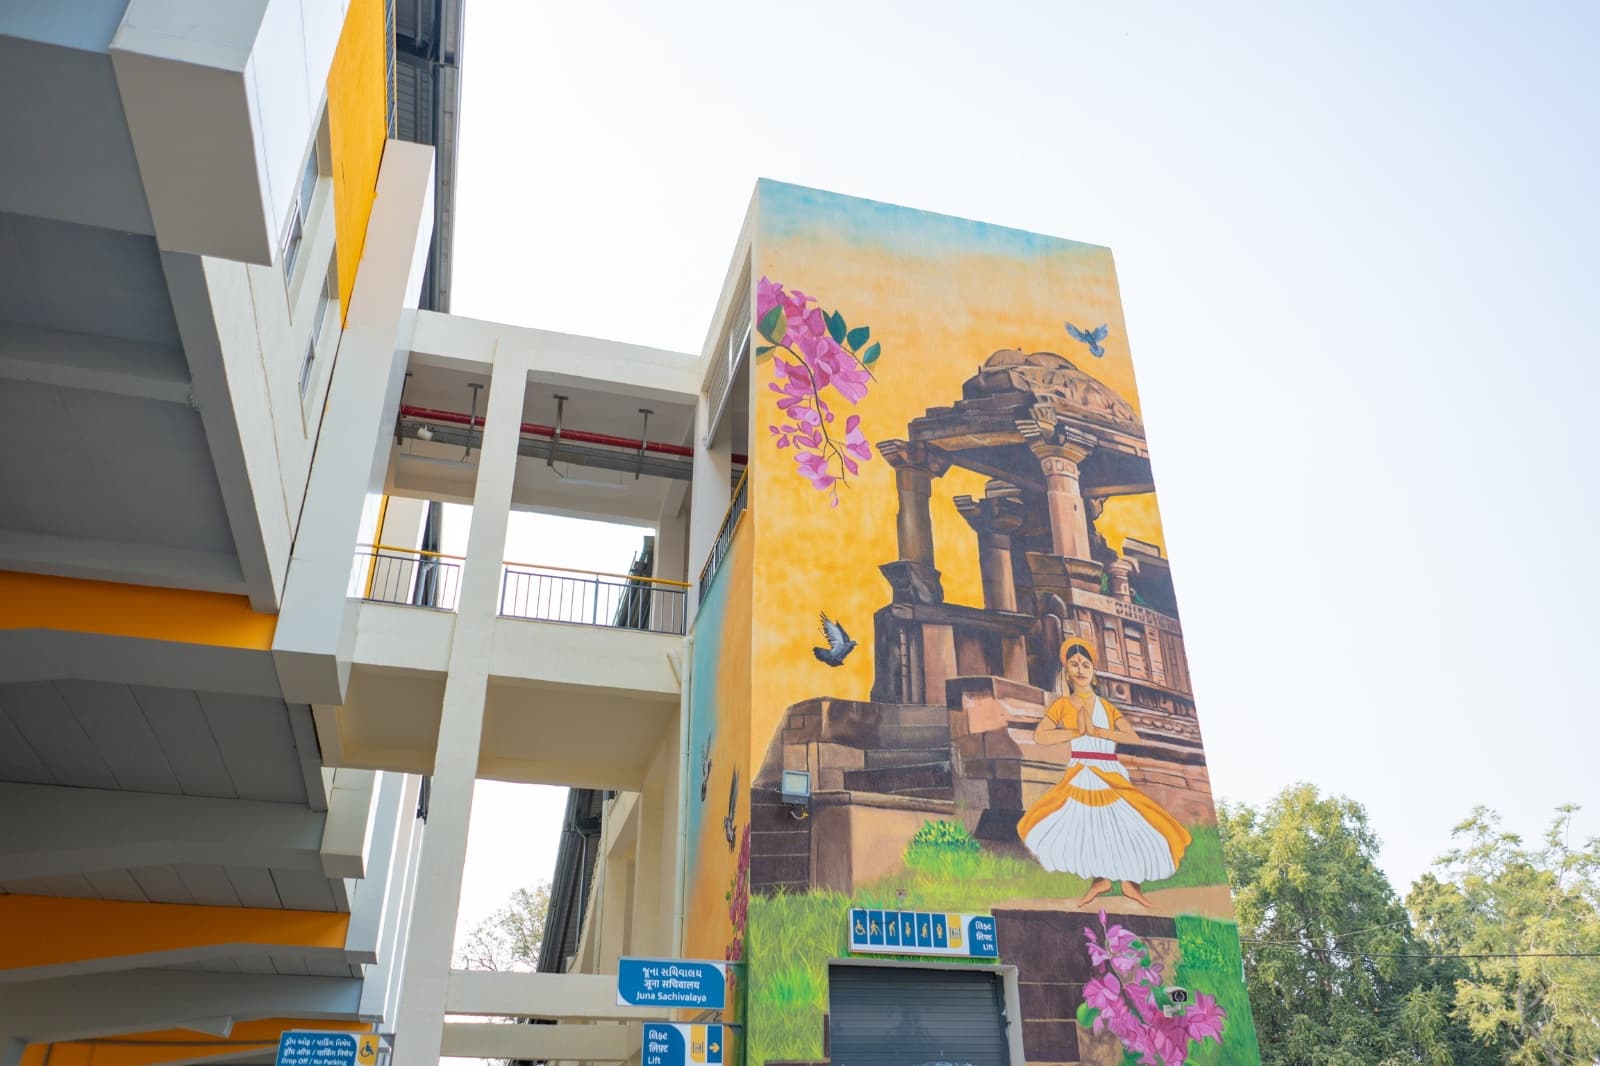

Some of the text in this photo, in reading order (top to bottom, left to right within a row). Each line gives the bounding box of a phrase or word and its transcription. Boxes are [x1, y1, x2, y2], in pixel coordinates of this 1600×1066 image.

[643, 966, 702, 978] જૂના સચિવાલય
[644, 978, 700, 990] जूना सचिवालय
[636, 992, 707, 1004] Juna Sachivalaya
[281, 1058, 297, 1066] Drop
[648, 1056, 661, 1065] Lift
